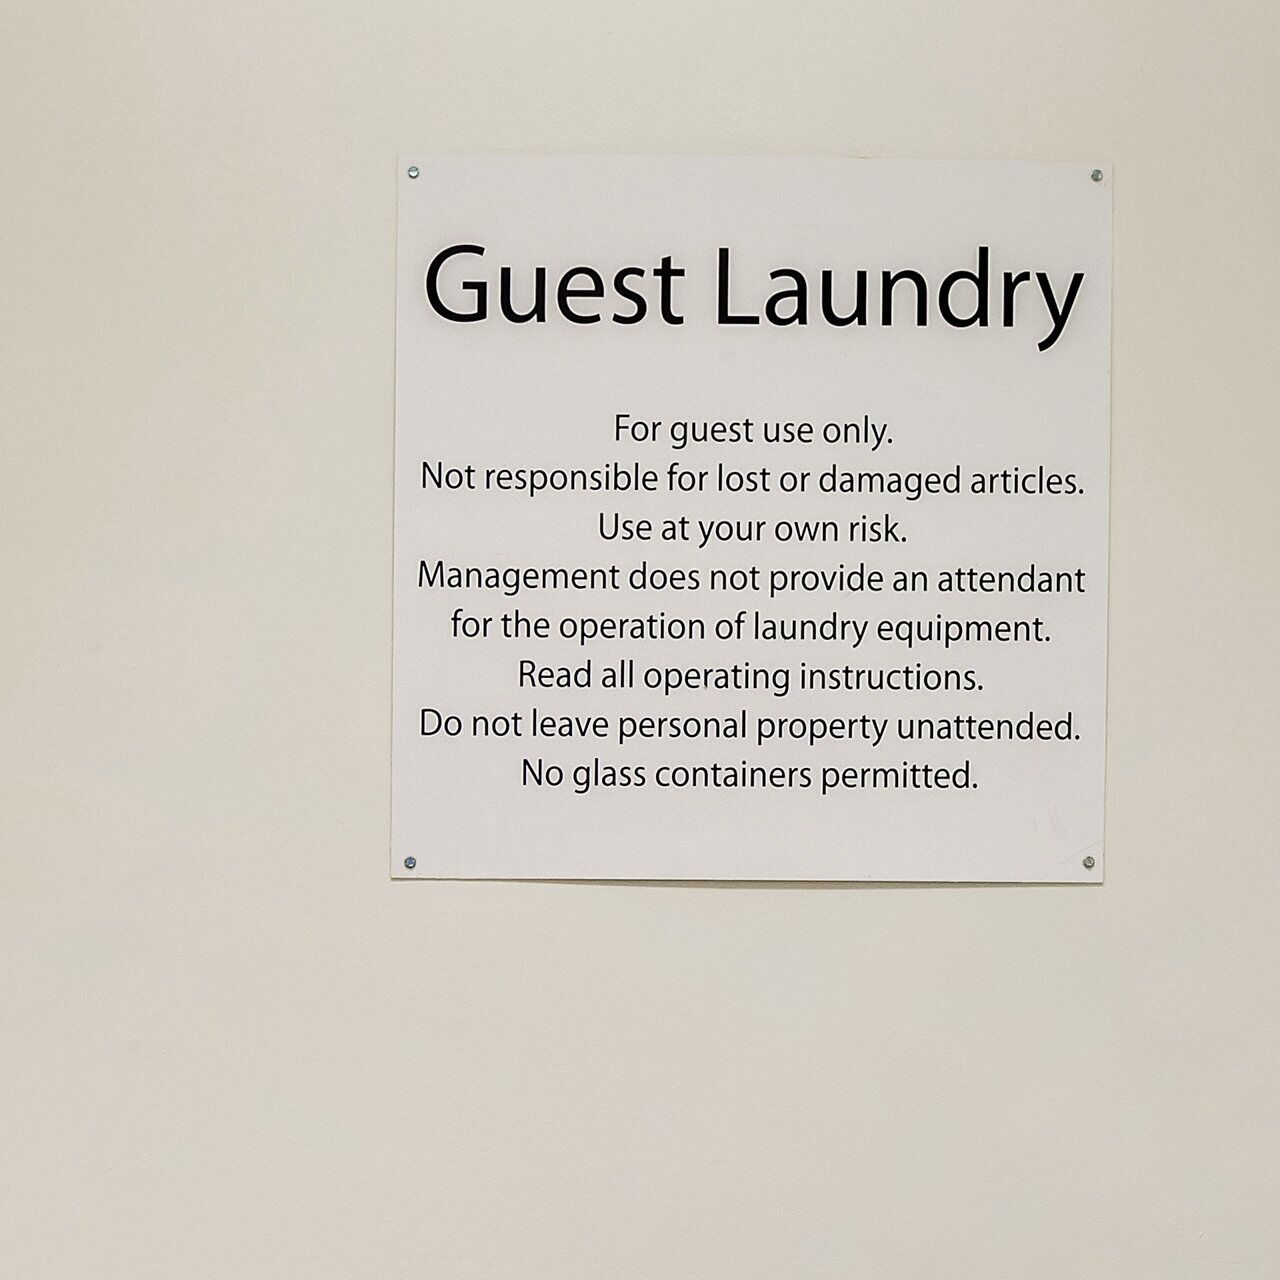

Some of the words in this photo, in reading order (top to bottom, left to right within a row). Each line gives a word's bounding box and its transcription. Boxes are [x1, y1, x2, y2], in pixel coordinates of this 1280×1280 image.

[425, 244, 686, 326] Guest
[717, 245, 1085, 352] Laundry
[615, 413, 662, 442] For
[670, 418, 754, 450] guest
[763, 422, 814, 444] use
[822, 414, 893, 452] only.
[422, 461, 476, 490] Not
[485, 461, 659, 498] responsible
[666, 462, 709, 492] for
[718, 462, 771, 493] lost
[779, 471, 811, 493] or
[819, 463, 961, 501] damaged
[970, 465, 1084, 495] articles.
[599, 512, 653, 541] Use
[661, 516, 690, 541] at
[698, 520, 767, 549] your
[774, 521, 839, 542] own
[849, 513, 907, 543] risk.
[418, 560, 621, 597] Management
[629, 560, 700, 591] does
[710, 566, 761, 591] not
[770, 562, 884, 599] provide
[892, 571, 928, 592] an
[937, 563, 1086, 593] attendant
[450, 608, 493, 638] for
[500, 609, 550, 639] the
[559, 611, 705, 646] operation
[715, 610, 747, 640] of
[754, 610, 869, 649] laundry
[877, 613, 1051, 649] equipment.
[519, 659, 592, 688] Read
[601, 659, 634, 689] all
[643, 661, 790, 698] operating
[800, 662, 984, 691] instructions.
[420, 708, 463, 737] Do
[472, 712, 523, 737] not
[532, 707, 609, 738] leave
[619, 709, 746, 745] personal
[757, 714, 889, 747] property
[897, 711, 1080, 741] unattended.
[522, 758, 564, 787] No
[572, 757, 646, 795] glass
[655, 760, 812, 788] containers
[822, 759, 978, 796] permitted.
